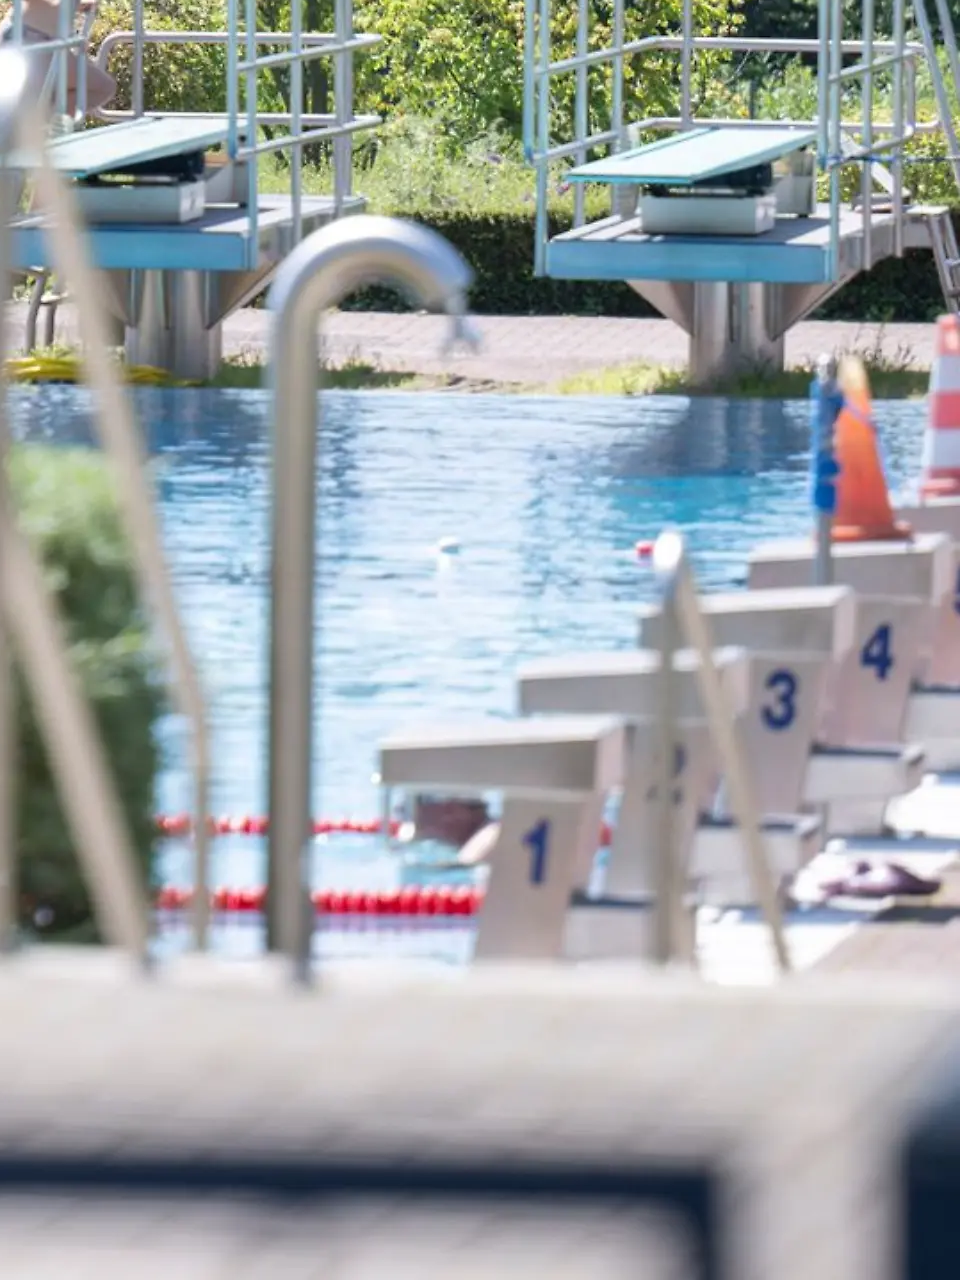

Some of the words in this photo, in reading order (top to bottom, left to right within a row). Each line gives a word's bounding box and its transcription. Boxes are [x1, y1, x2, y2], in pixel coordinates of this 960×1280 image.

[861, 622, 894, 681] 4
[762, 668, 797, 731] 3
[521, 817, 550, 884] 1
